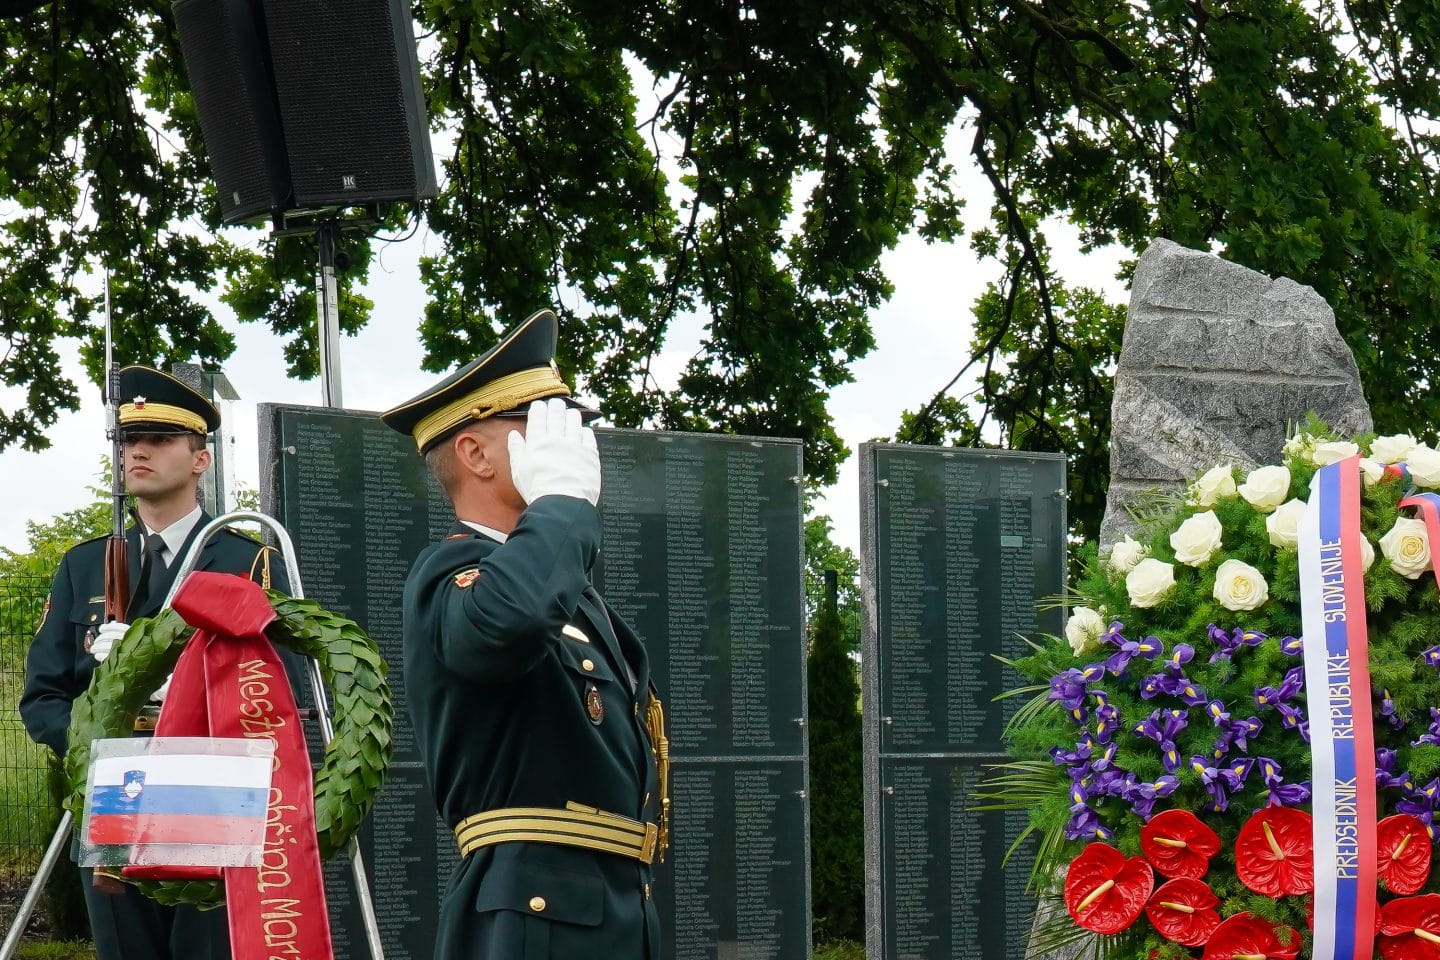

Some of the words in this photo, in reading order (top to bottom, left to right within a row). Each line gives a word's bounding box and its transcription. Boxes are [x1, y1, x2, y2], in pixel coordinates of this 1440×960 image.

[1321, 537, 1347, 623] SLOVENIJE
[238, 659, 285, 773] Mestn
[1327, 649, 1355, 740] REPUBLIKE
[1335, 777, 1358, 880] PREDSEDNIK
